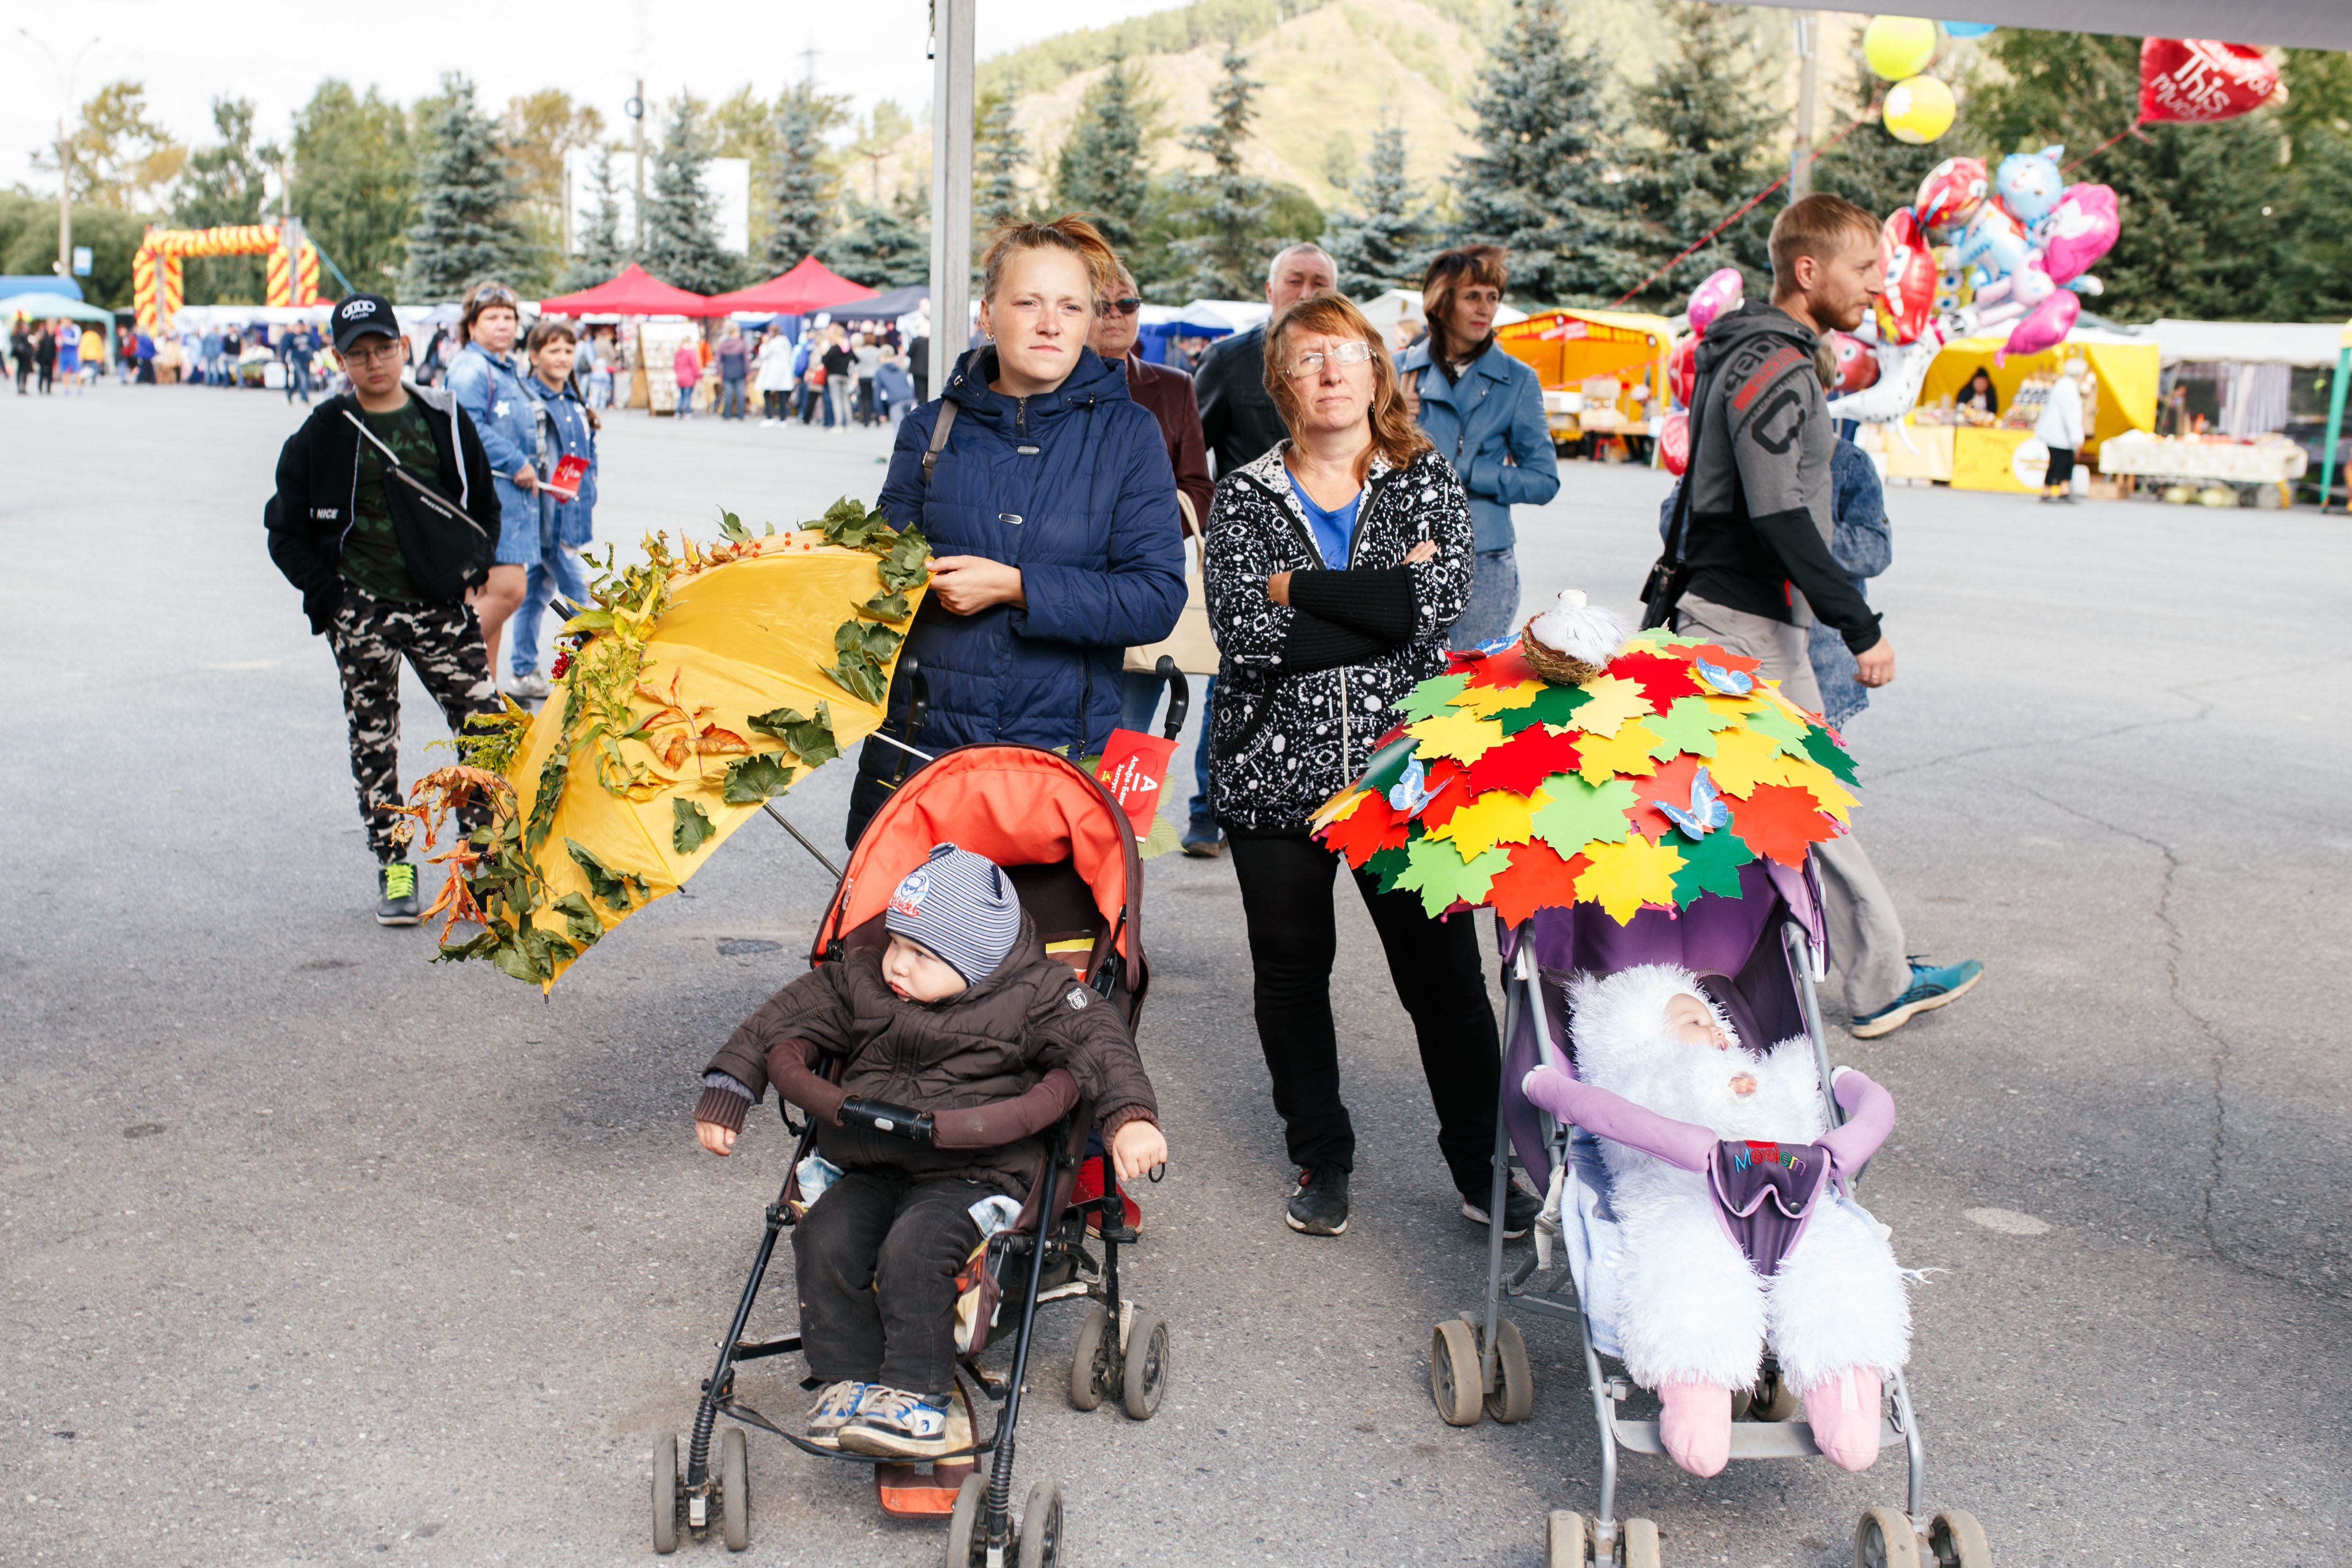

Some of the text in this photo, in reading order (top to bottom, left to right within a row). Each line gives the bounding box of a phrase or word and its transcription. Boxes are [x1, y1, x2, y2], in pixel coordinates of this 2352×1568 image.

[2173, 39, 2231, 114] This
[317, 508, 339, 519] NICE
[1110, 763, 1126, 794] Златоуст
